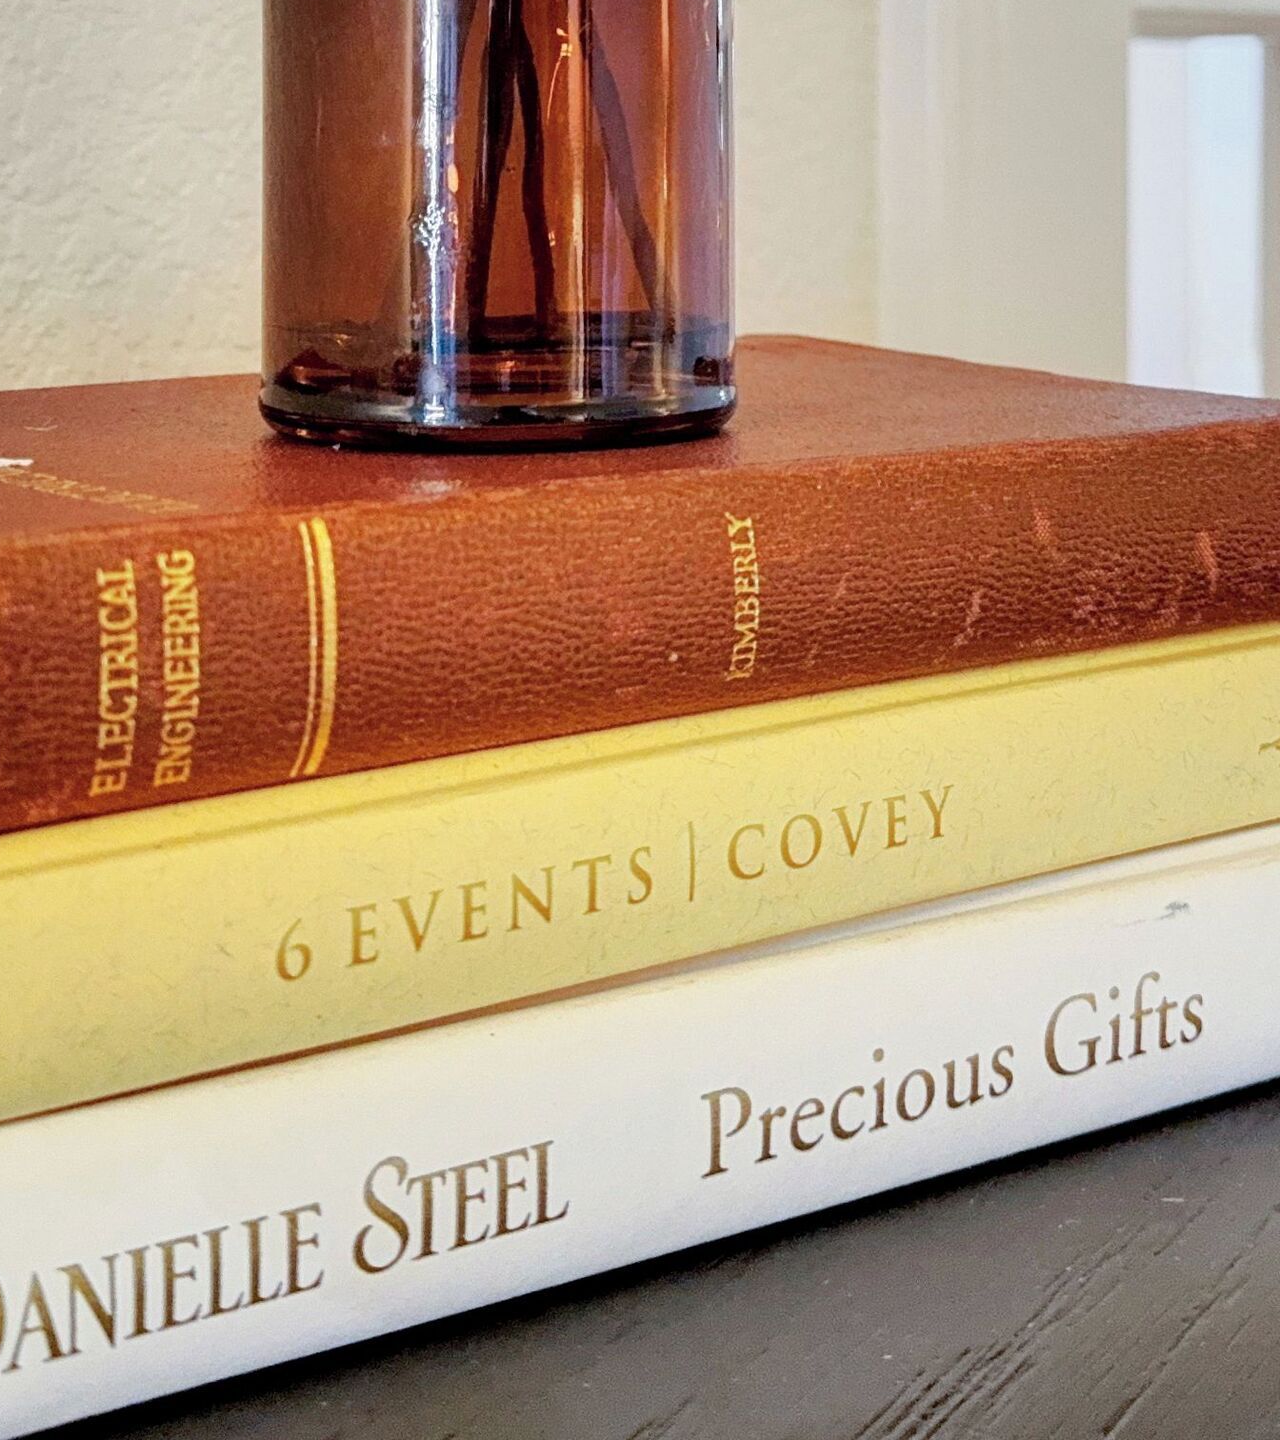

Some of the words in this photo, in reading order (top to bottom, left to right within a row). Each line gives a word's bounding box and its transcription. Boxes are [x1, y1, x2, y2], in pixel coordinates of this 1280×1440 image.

[88, 558, 139, 798] ELECTRICAL
[153, 548, 201, 787] ENGINEERING
[724, 511, 760, 682] KIMBERLY
[275, 917, 312, 982] 6
[345, 844, 654, 968] EVENTS
[727, 783, 954, 881] COVEY
[700, 1047, 1015, 1179] Precious
[1043, 970, 1205, 1077] Gifts
[351, 1139, 571, 1276] STEEL
